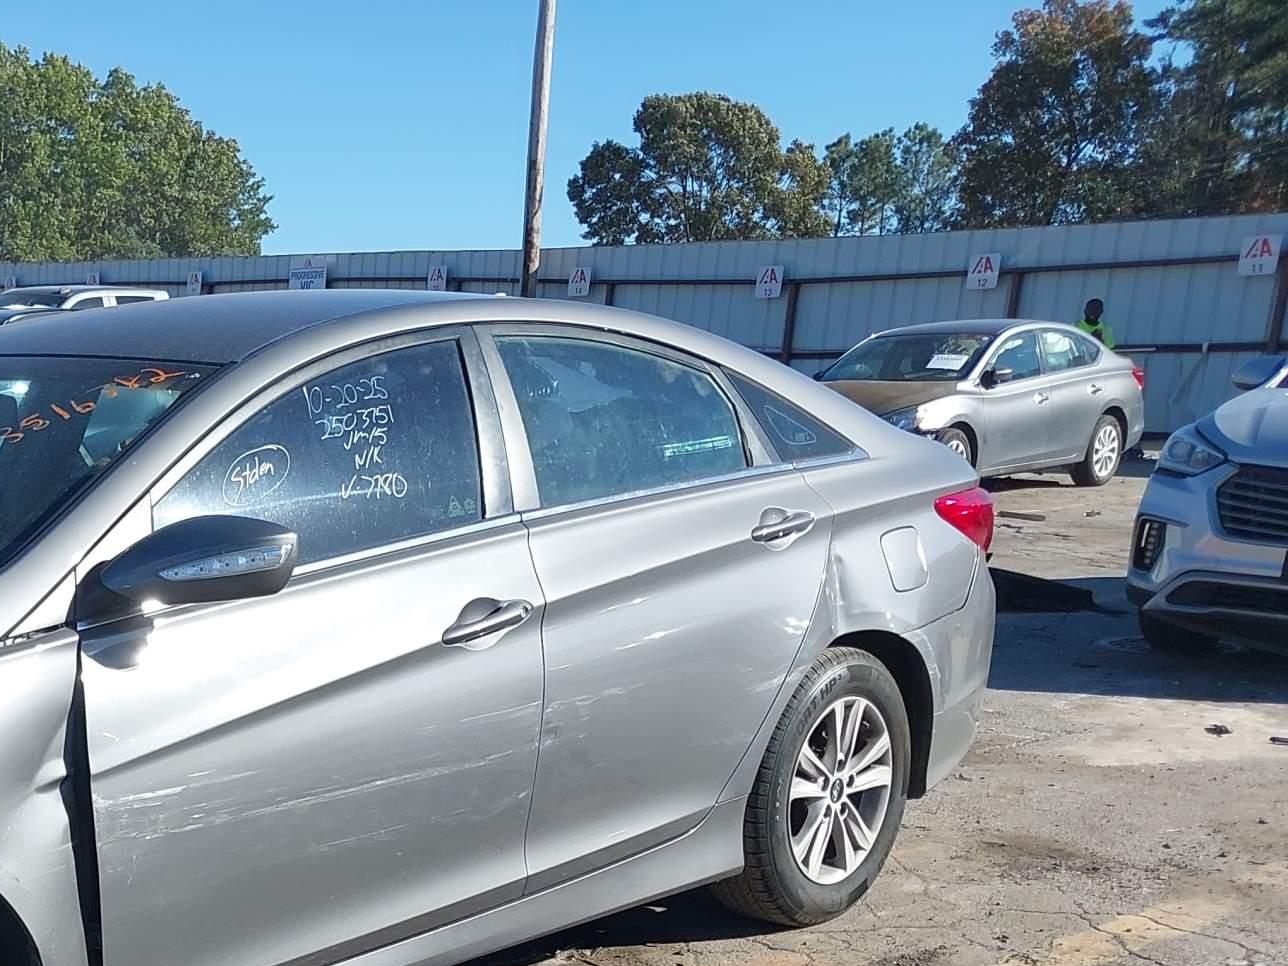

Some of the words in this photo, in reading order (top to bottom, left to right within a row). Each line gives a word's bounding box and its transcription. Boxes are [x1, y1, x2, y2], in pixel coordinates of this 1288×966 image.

[290, 270, 325, 280] PROGRESSIVE
[977, 279, 988, 288] 12
[763, 288, 773, 297] 13
[303, 376, 389, 419] 10-20-25
[314, 404, 395, 440] 2503751
[354, 445, 383, 470] N/K
